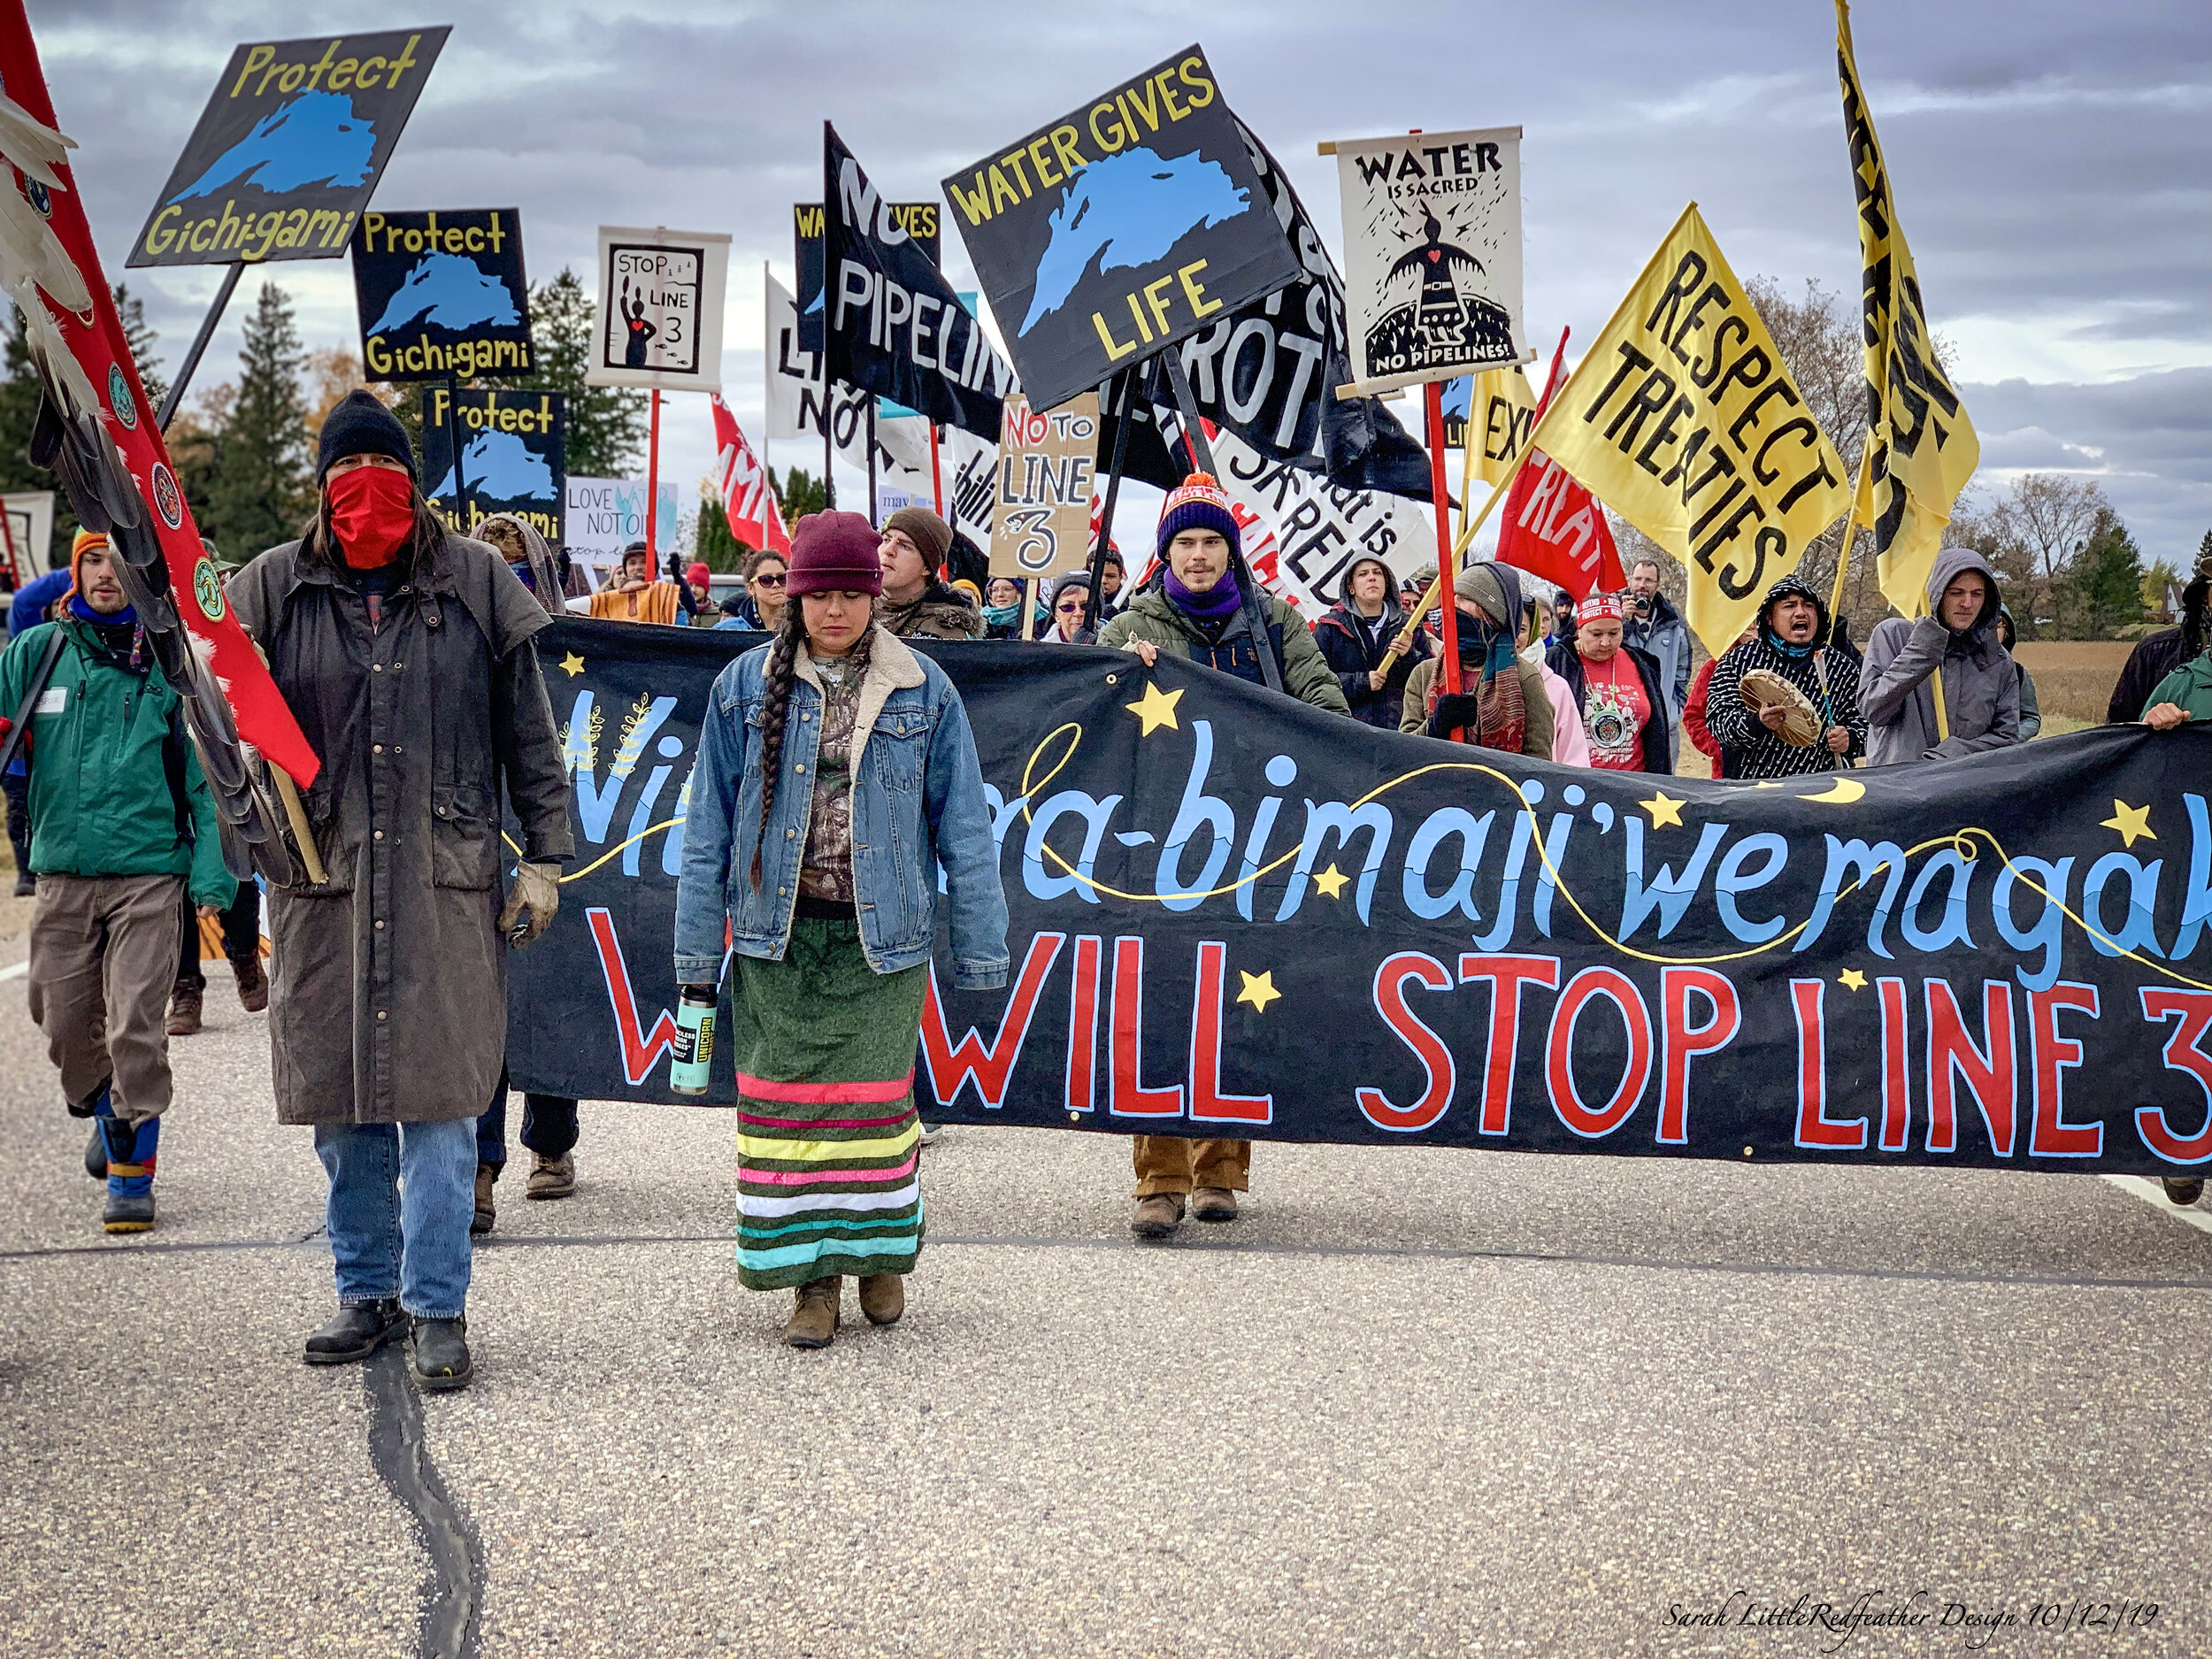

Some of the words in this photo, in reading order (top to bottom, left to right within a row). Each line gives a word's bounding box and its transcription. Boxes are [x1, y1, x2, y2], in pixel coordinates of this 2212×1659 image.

[230, 35, 422, 97] Protect
[951, 126, 1087, 226] WATER
[1089, 56, 1215, 153] GIVES
[1355, 142, 1502, 187] WATER
[1387, 185, 1402, 199] IS
[1407, 178, 1479, 197] SACRED
[364, 211, 506, 253] Protect
[618, 255, 668, 275] STOP
[649, 289, 688, 308] LINE
[1092, 258, 1224, 361] LIFE
[665, 317, 681, 343] 3
[1375, 353, 1406, 373] NO
[1410, 343, 1510, 366] PIPELINES!
[1646, 250, 1839, 515] RESPECT
[1004, 401, 1050, 450] NO
[1051, 411, 1094, 439] TO
[1001, 454, 1093, 505] LINE
[1583, 340, 1786, 599] TREATIES
[569, 488, 612, 510] LOVE
[615, 485, 668, 512] WATR
[588, 512, 624, 535] NOT
[626, 514, 649, 535] OI
[1358, 511, 1397, 557] is
[697, 1018, 712, 1062] UNICORN
[917, 932, 1273, 1125] WILL
[1356, 951, 1741, 1145] STOP
[1789, 976, 2104, 1158] LINE
[2135, 985, 2212, 1165] 3
